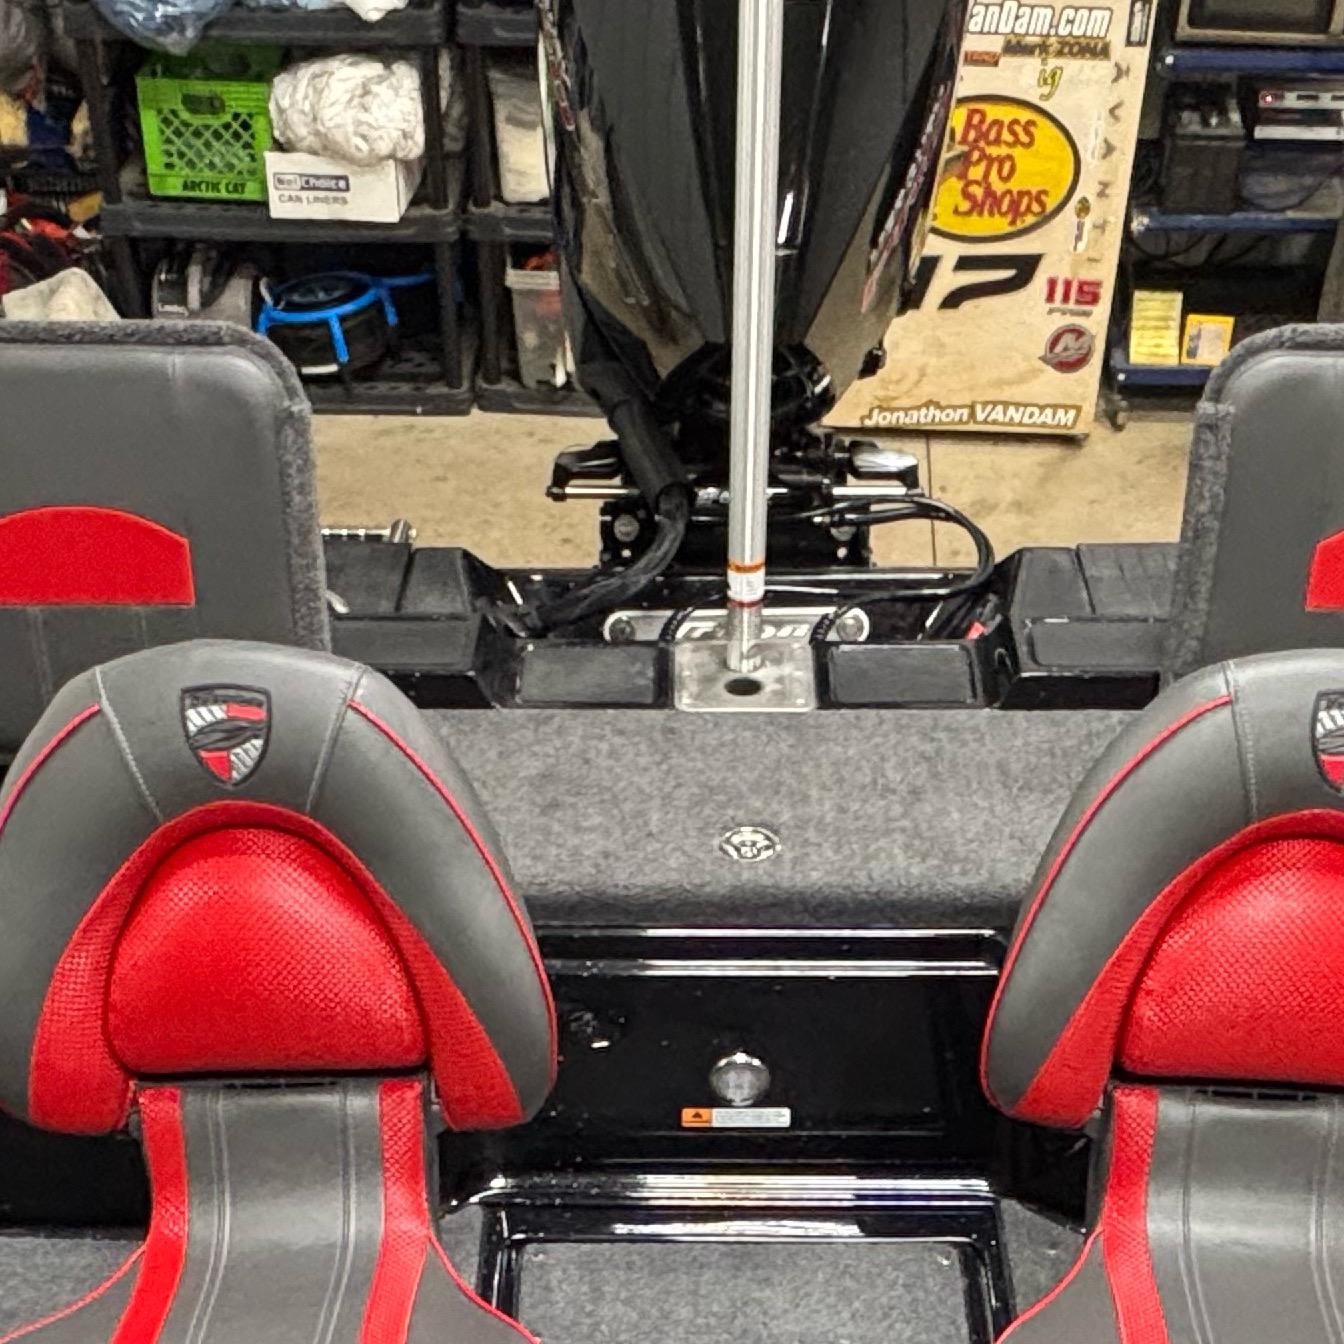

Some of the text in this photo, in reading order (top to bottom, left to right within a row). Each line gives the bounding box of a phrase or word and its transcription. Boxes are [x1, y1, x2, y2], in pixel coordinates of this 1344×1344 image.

[959, 108, 1038, 148] Bass
[962, 146, 1016, 183] Pro
[182, 179, 247, 194] ARCTIC CAT
[278, 193, 303, 204] CAN
[952, 180, 1049, 226] Shops
[1046, 277, 1103, 306] 115
[864, 403, 1077, 427] Jonathon VANDAM
